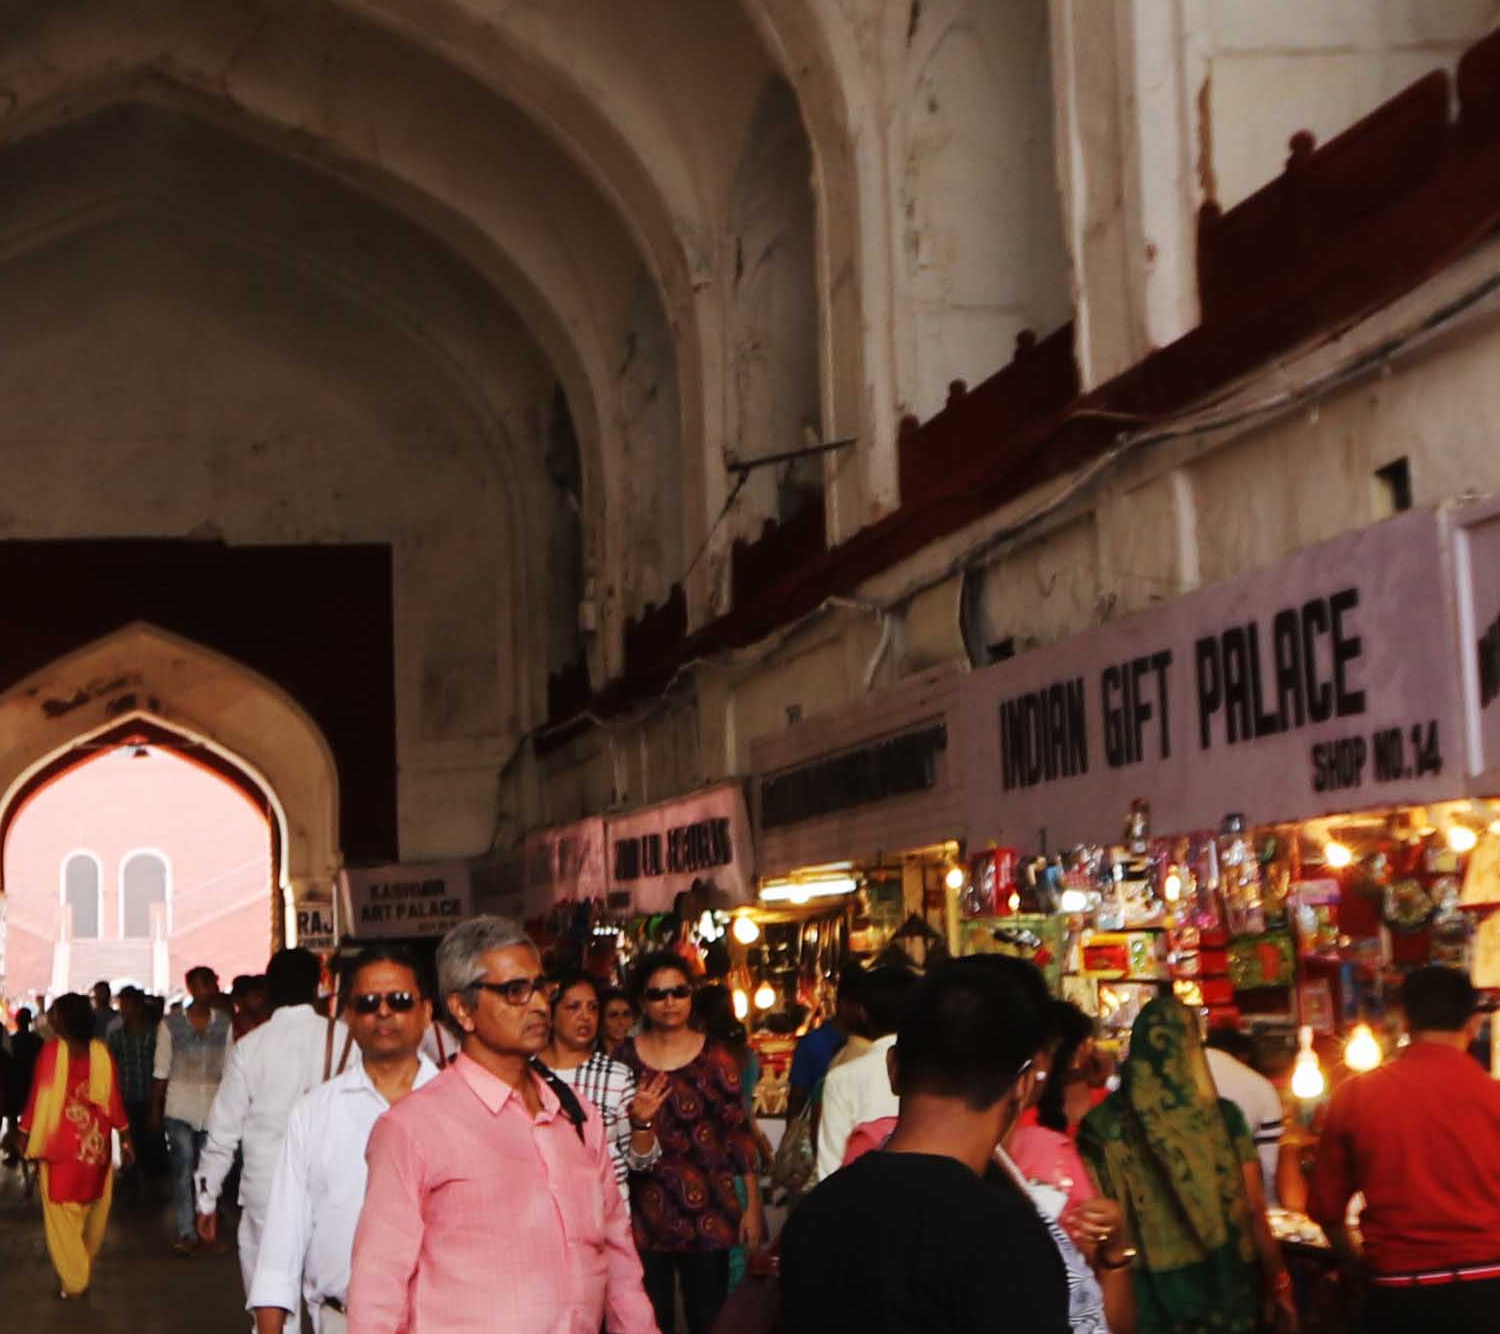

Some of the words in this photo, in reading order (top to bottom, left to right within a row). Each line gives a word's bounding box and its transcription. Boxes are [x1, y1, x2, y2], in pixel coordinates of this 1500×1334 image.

[999, 677, 1088, 791] INDIAN
[1101, 649, 1173, 768] GIFT
[1195, 587, 1367, 750] PALACE
[1311, 735, 1367, 793] SHOP
[361, 905, 393, 923] ART
[396, 898, 461, 921] PALACE
